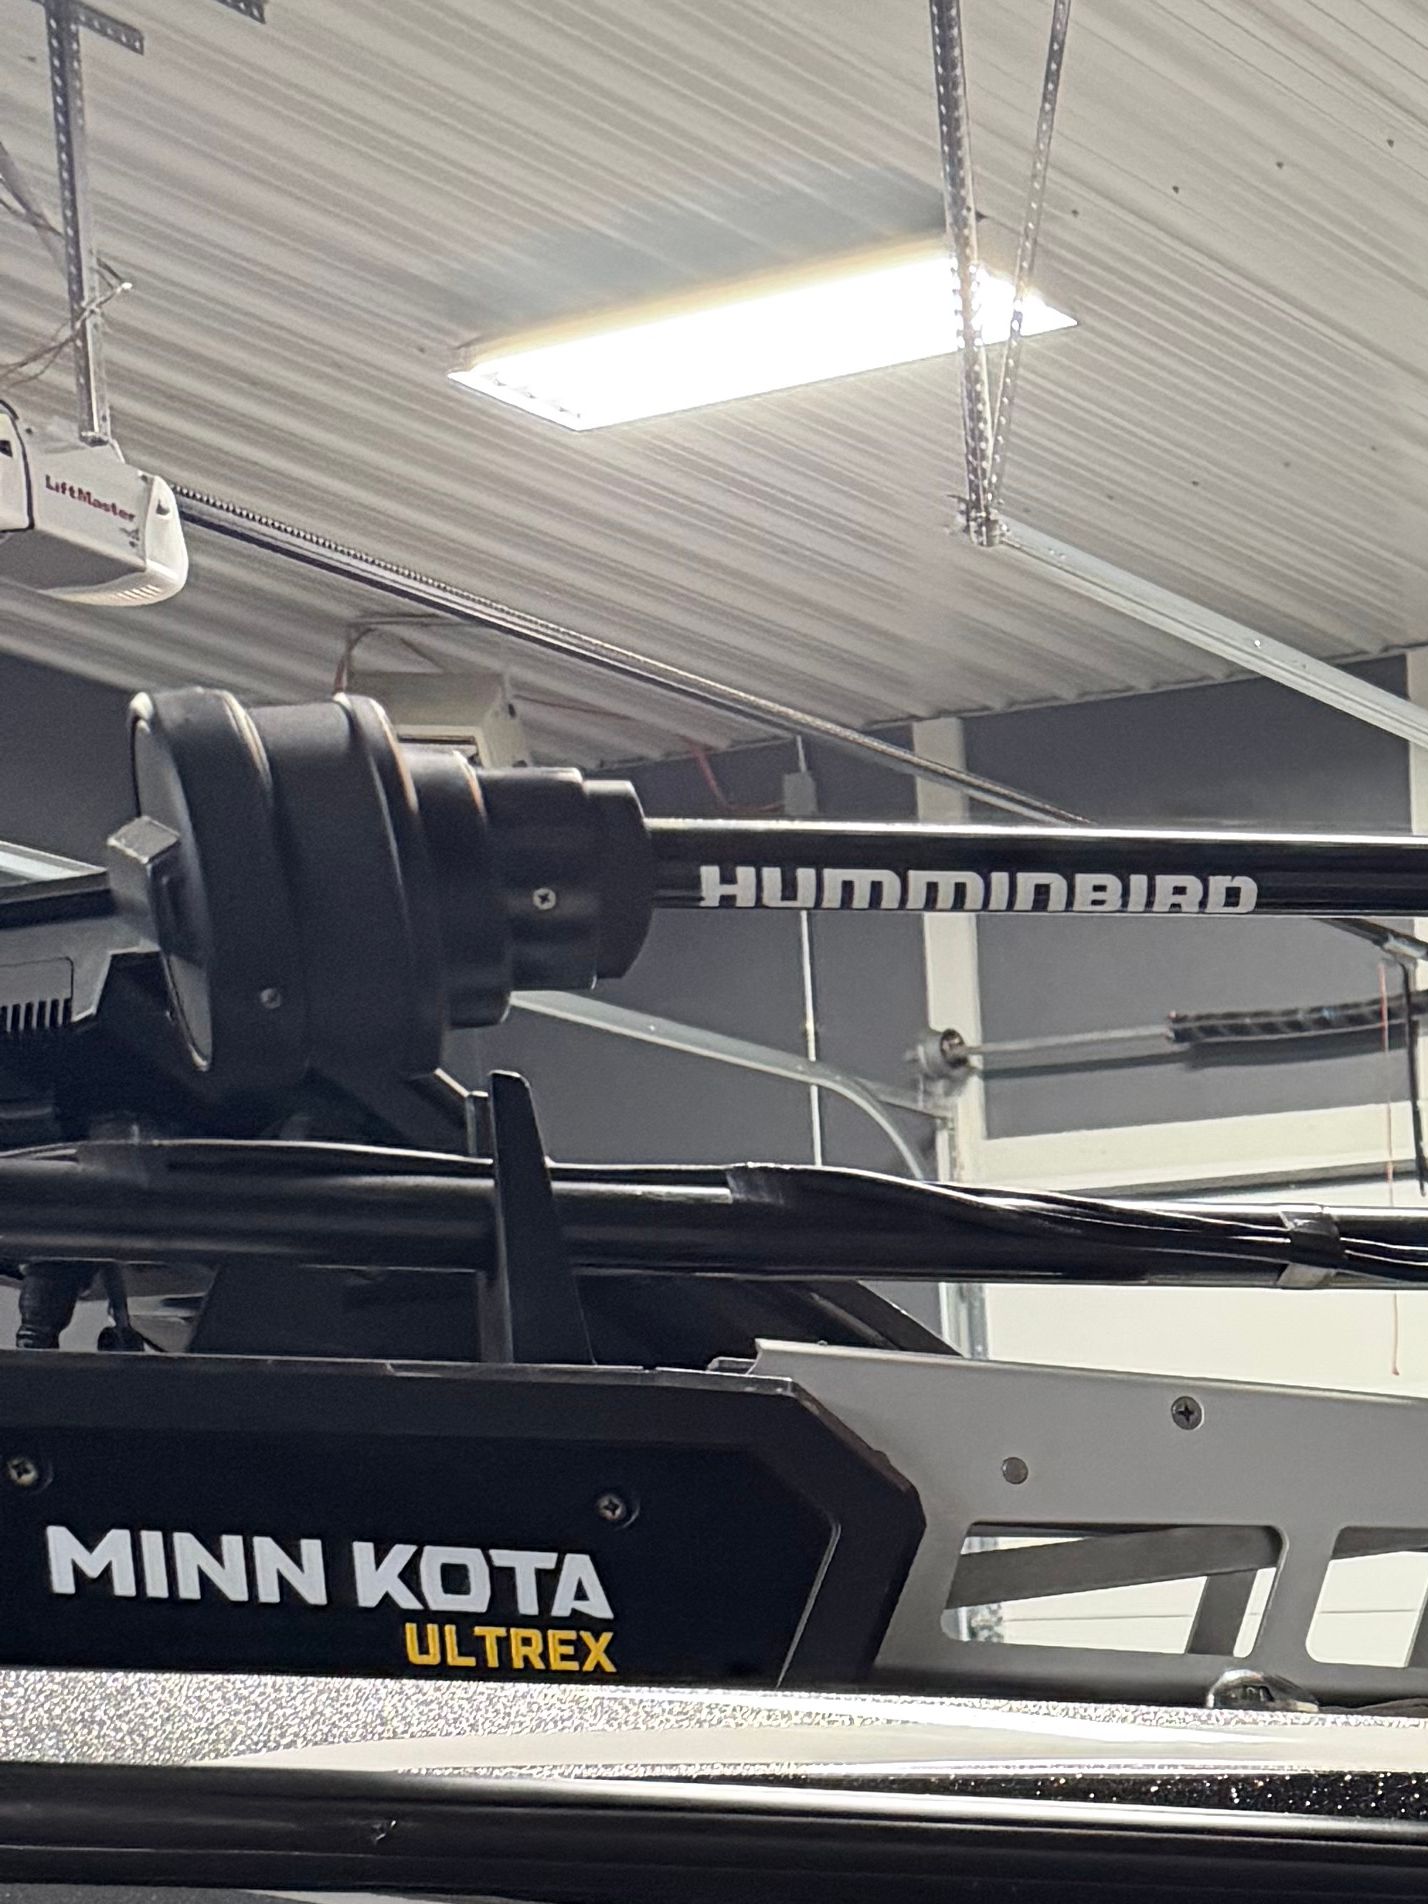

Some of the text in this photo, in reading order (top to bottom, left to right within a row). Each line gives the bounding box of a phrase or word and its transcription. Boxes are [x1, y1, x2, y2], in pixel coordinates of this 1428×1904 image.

[45, 474, 136, 522] LiftMaster
[700, 866, 1258, 914] HUMMINBIRD
[47, 1526, 613, 1619] MINN KOTA
[405, 1623, 617, 1673] ULTREX
